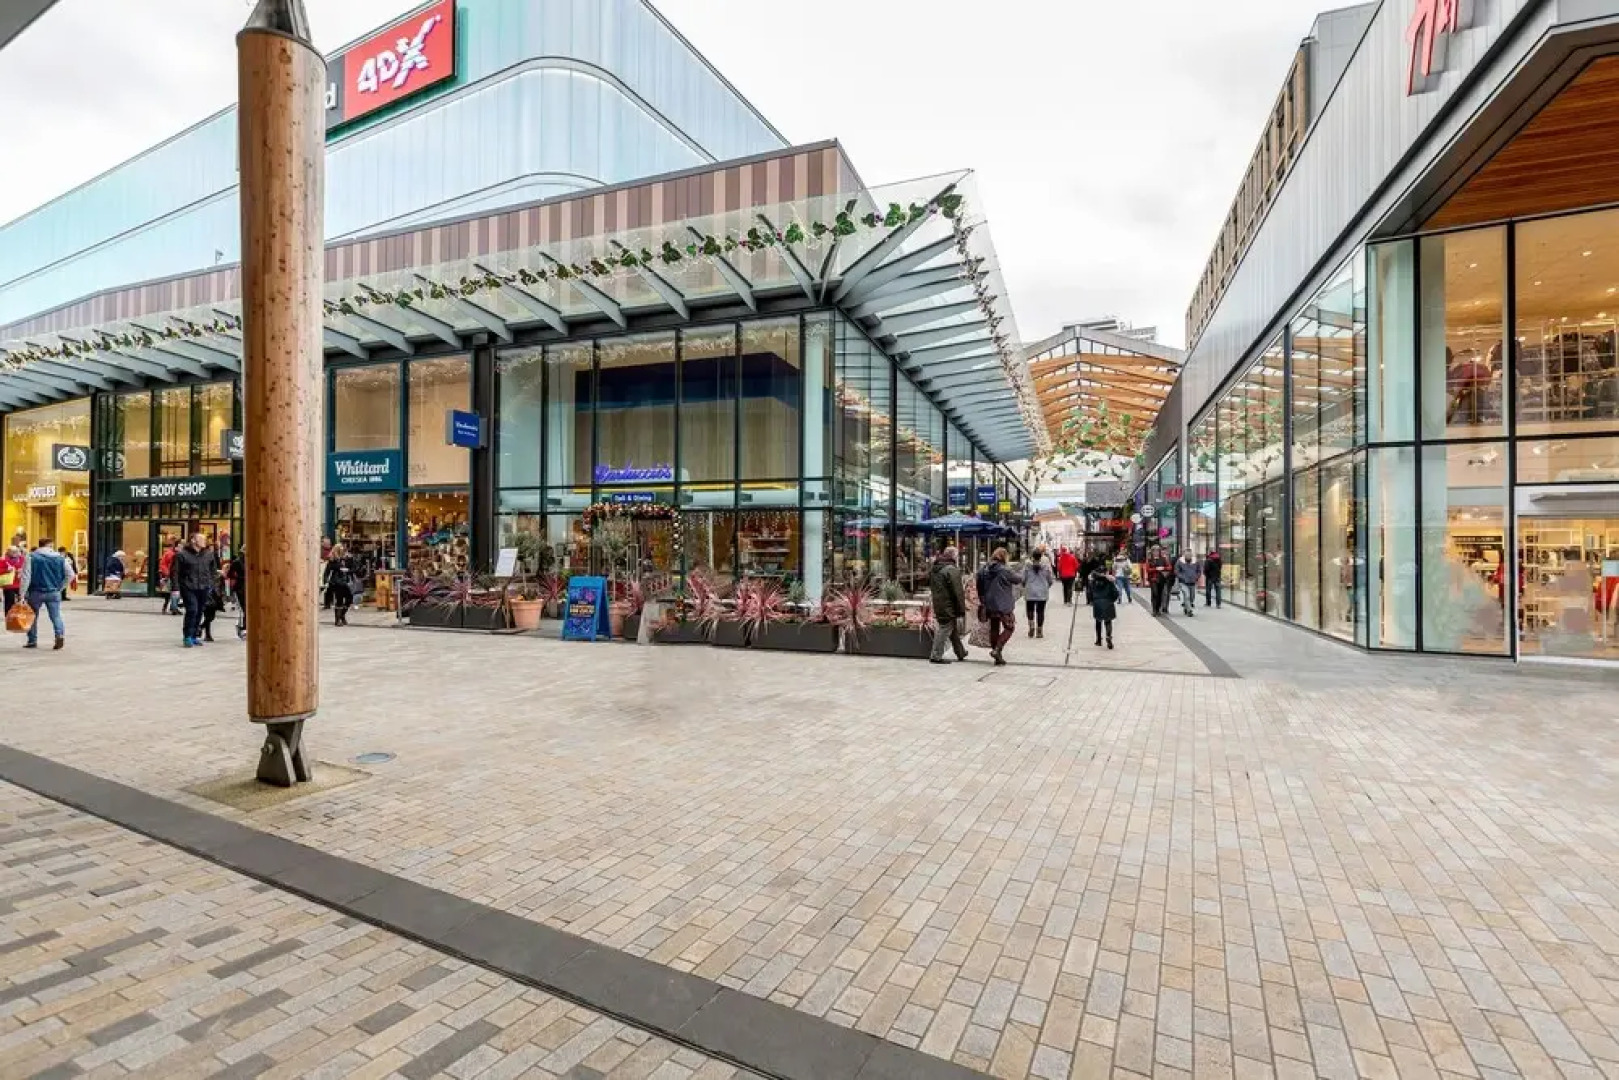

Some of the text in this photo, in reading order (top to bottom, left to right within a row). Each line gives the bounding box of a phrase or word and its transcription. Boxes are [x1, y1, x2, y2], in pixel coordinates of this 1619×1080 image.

[357, 13, 442, 93] 4DX
[335, 457, 390, 476] Whittard
[130, 482, 206, 498] THE BODY SHOP
